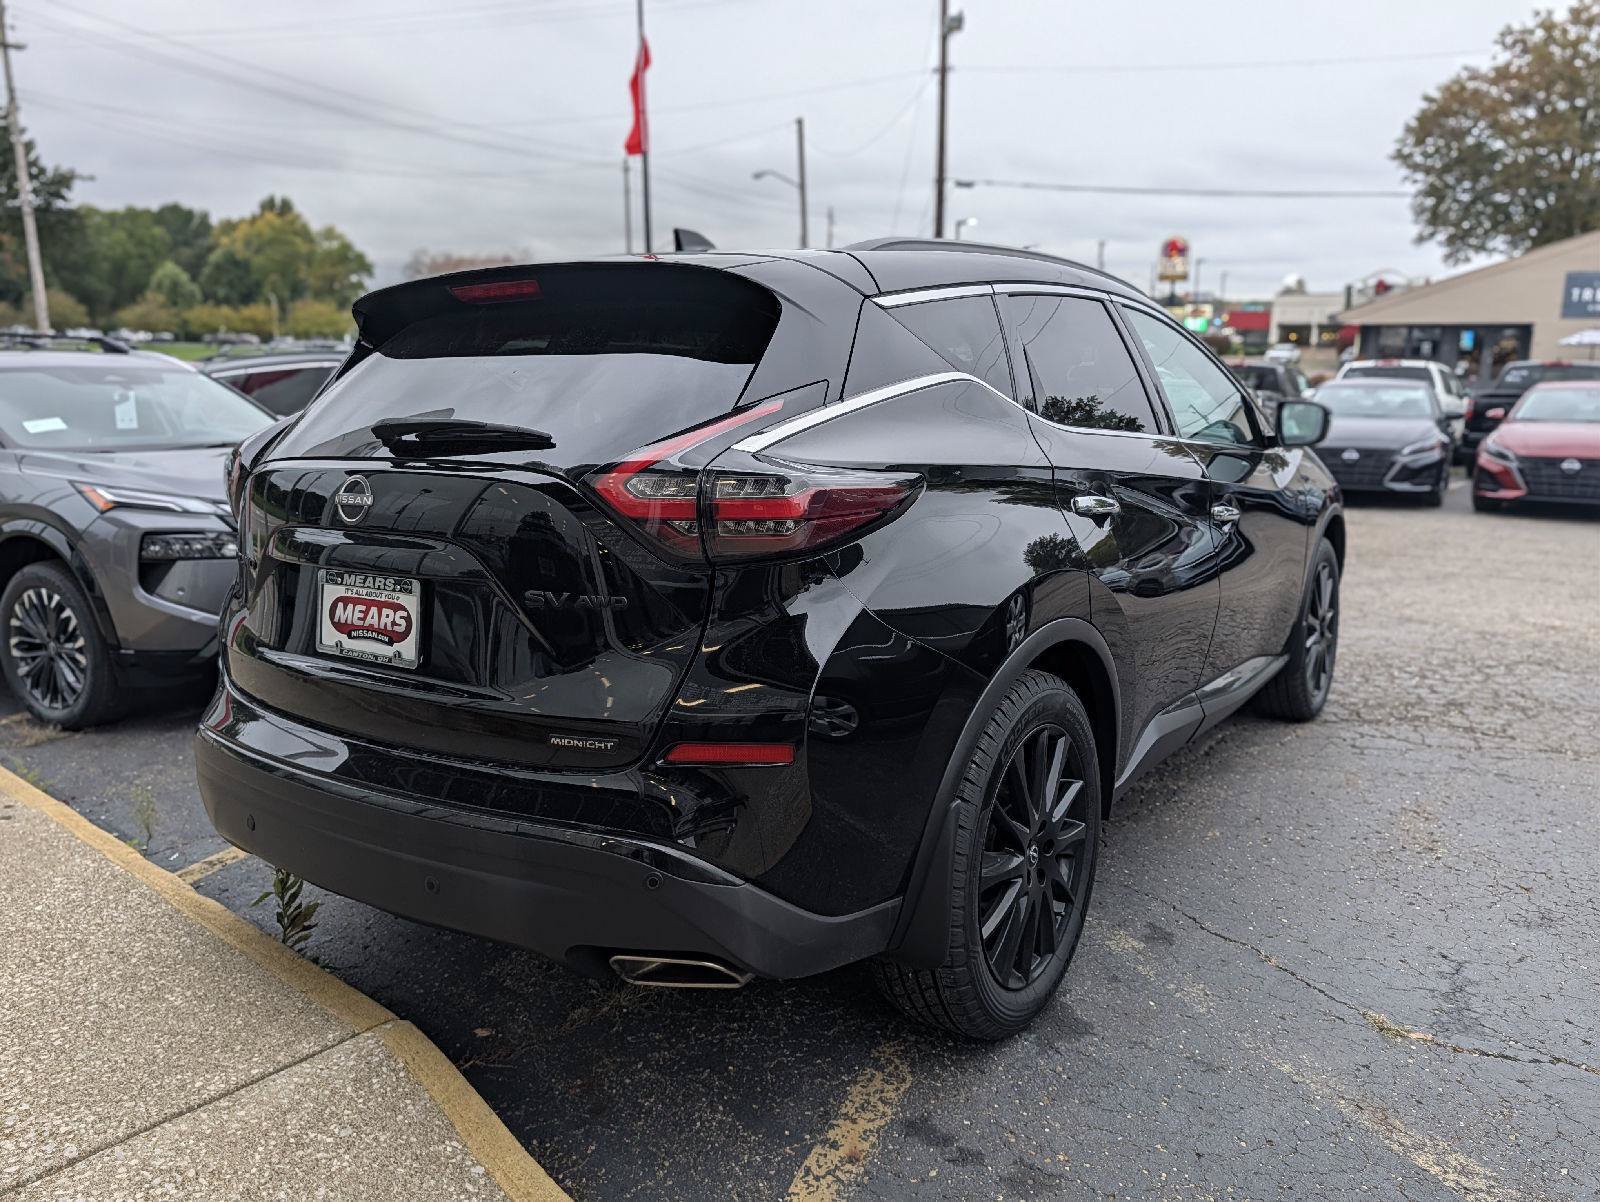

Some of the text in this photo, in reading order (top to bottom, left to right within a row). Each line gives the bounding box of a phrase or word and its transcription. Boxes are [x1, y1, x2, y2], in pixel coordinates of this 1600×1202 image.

[335, 494, 372, 505] NISSAN
[343, 573, 396, 591] MEARS
[355, 589, 365, 597] ALL
[365, 590, 383, 599] ABOUT
[525, 590, 628, 609] SV AWD
[334, 601, 408, 633] MEARS
